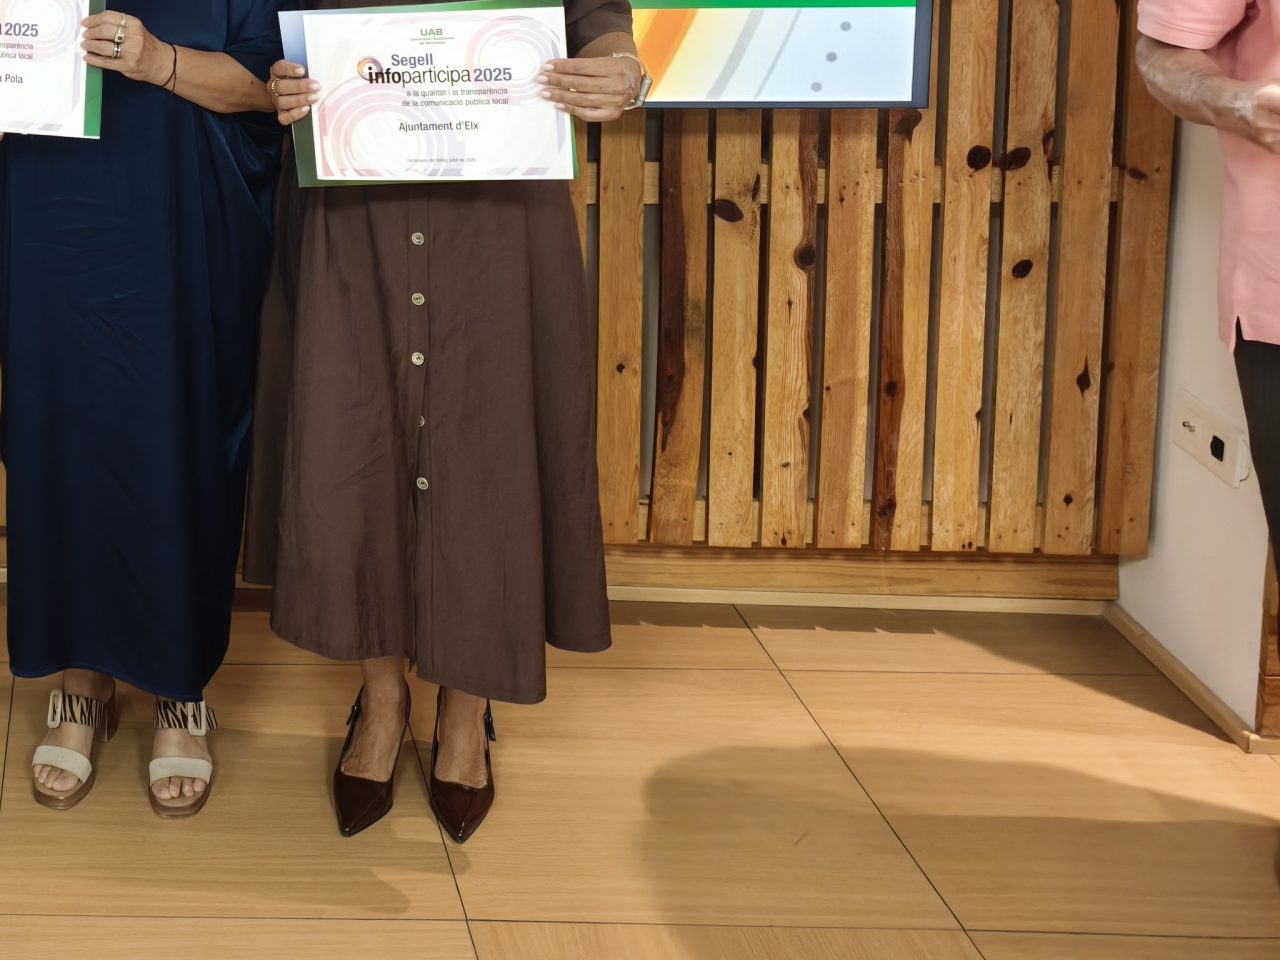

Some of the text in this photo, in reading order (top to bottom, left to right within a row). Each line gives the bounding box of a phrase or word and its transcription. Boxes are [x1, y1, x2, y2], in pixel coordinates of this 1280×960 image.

[4, 22, 39, 38] 2025
[420, 28, 443, 37] UAB
[391, 53, 434, 69] Segell
[5, 73, 24, 84] Pola
[368, 65, 513, 89] infoparticipa 2025
[398, 120, 479, 133] Ajuntament d'Elx
